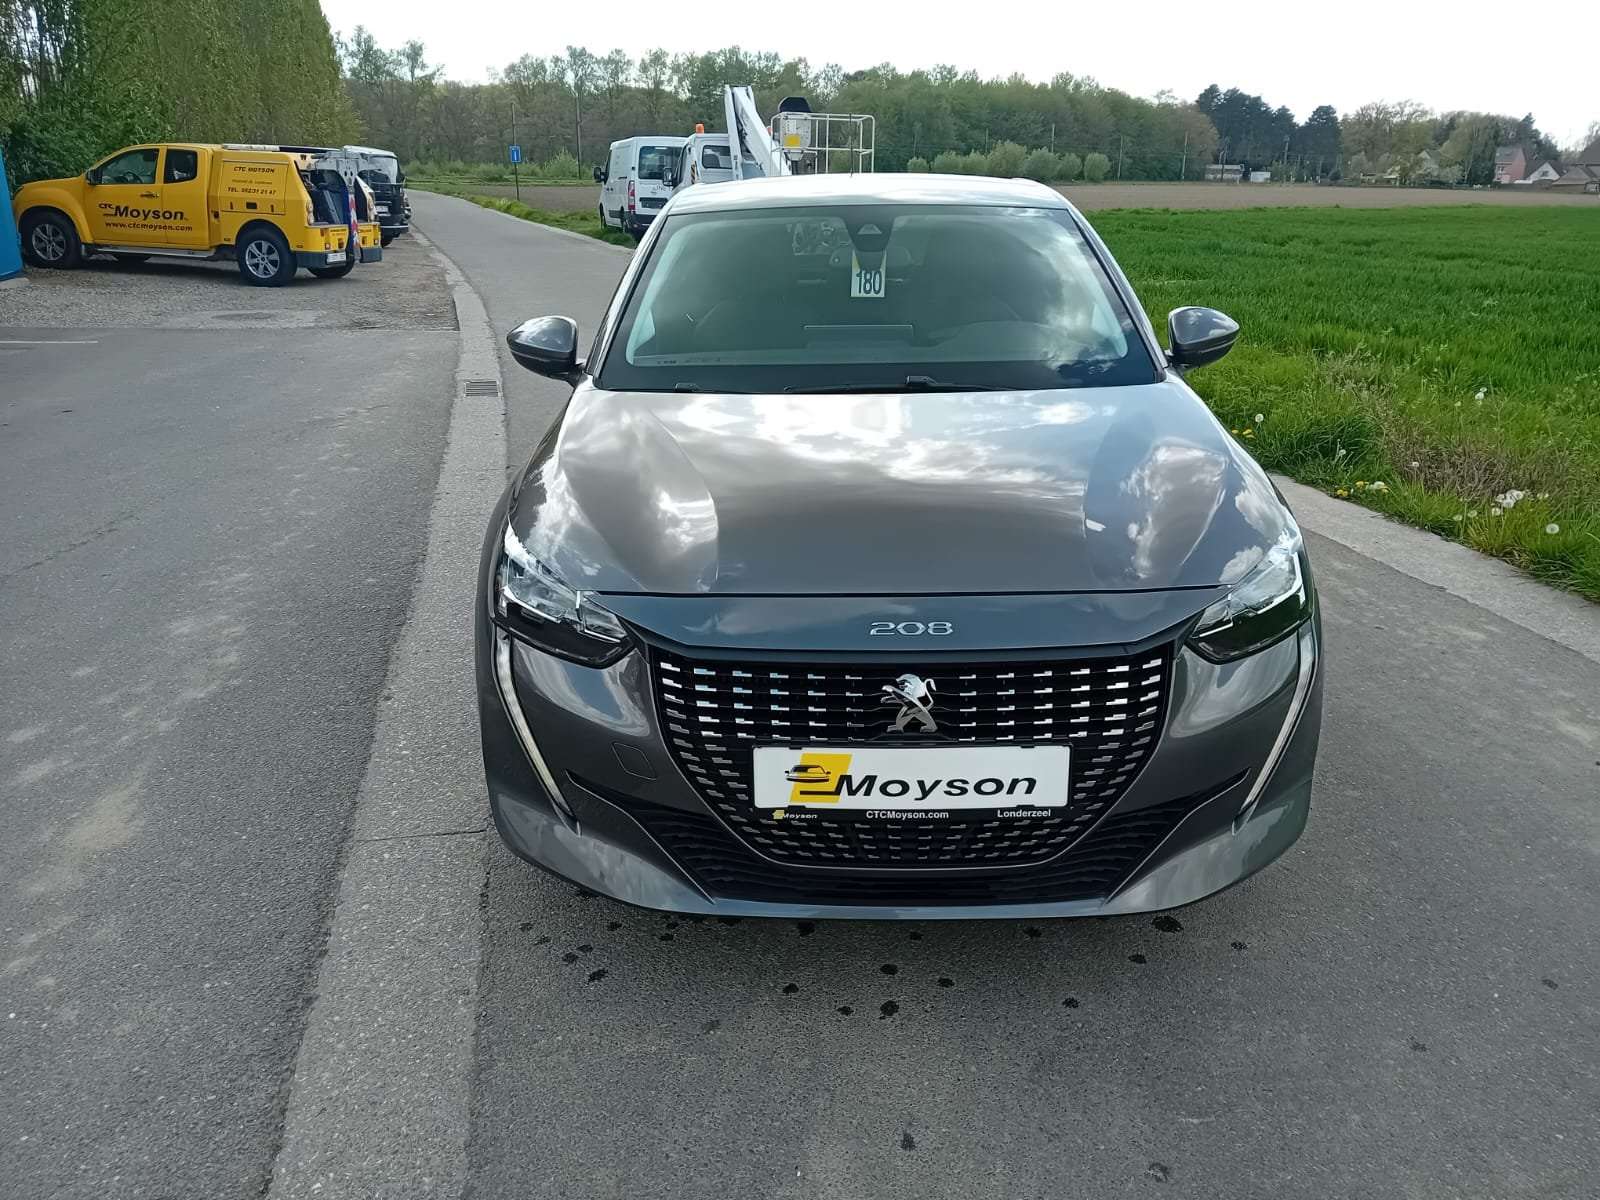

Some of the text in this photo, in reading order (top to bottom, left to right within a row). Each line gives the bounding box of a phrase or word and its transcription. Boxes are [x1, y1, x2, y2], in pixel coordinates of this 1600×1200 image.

[114, 205, 184, 221] Moyson
[105, 221, 193, 232] www.ctcmoyson.com
[856, 270, 882, 295] 180
[870, 621, 953, 636] 208
[834, 774, 1037, 801] Moyson
[866, 810, 949, 820] CTCMoyson.com
[997, 809, 1051, 818] Londerzeel
